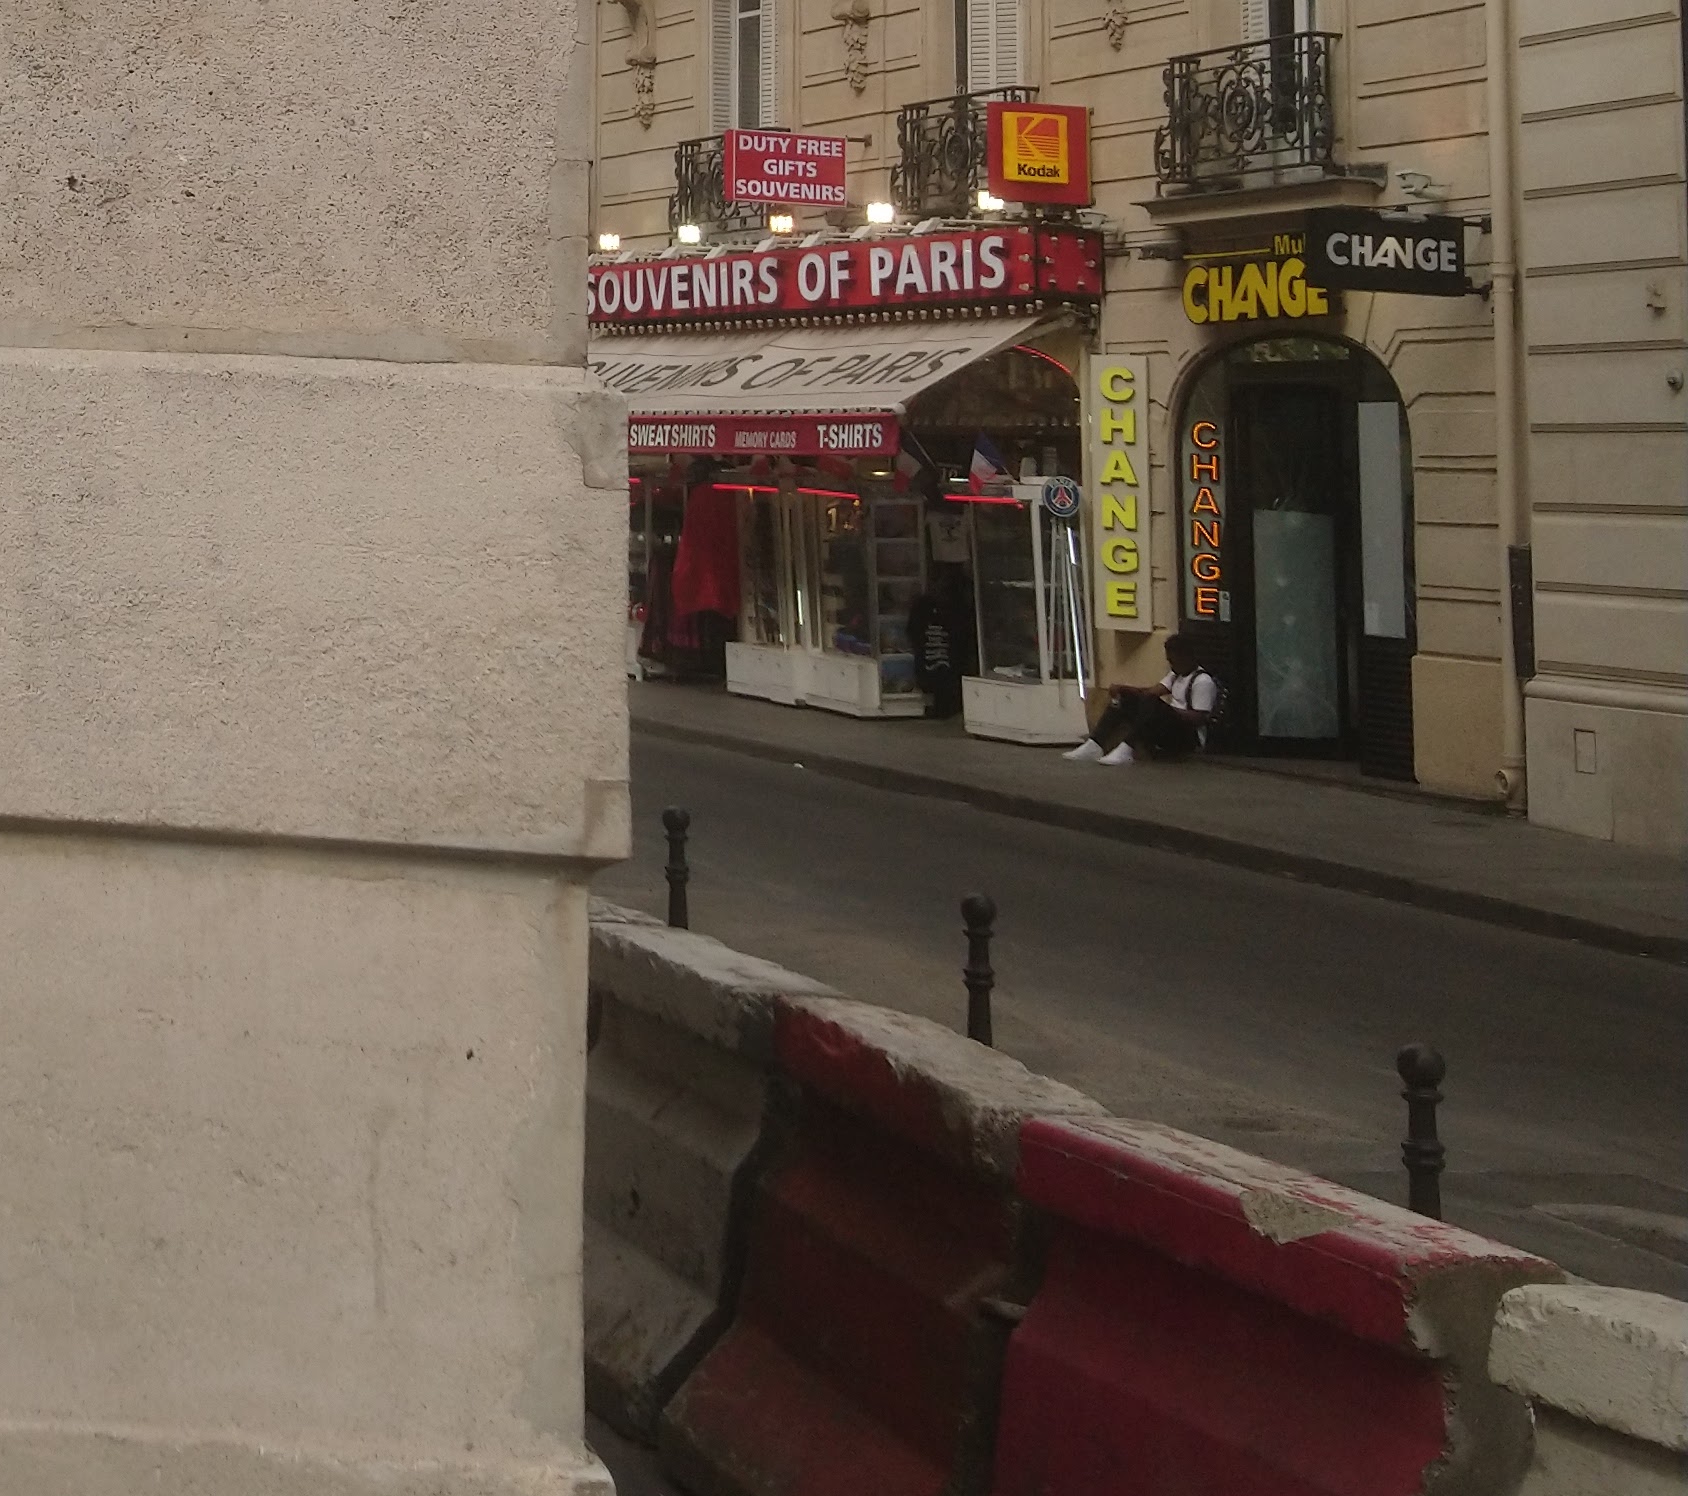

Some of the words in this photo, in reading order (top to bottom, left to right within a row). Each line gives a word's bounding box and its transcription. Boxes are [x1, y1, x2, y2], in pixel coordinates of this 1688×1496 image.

[738, 134, 791, 154] DUTY
[796, 137, 844, 158] FREE
[763, 158, 817, 178] GIFTS
[1017, 163, 1061, 178] Kodak
[735, 178, 846, 202] SOUVENIRS
[1273, 232, 1306, 256] Mu
[1326, 231, 1457, 272] CHANGE
[797, 250, 851, 302] OF
[870, 235, 1007, 296] PARIS
[740, 355, 837, 390] OF
[802, 347, 973, 387] PARIS
[734, 430, 768, 449] MEMORY
[769, 430, 798, 449] CARDS
[816, 422, 883, 450] T-SHIRTS
[1099, 366, 1140, 618] CHANGE
[1190, 420, 1222, 616] CHANGE
